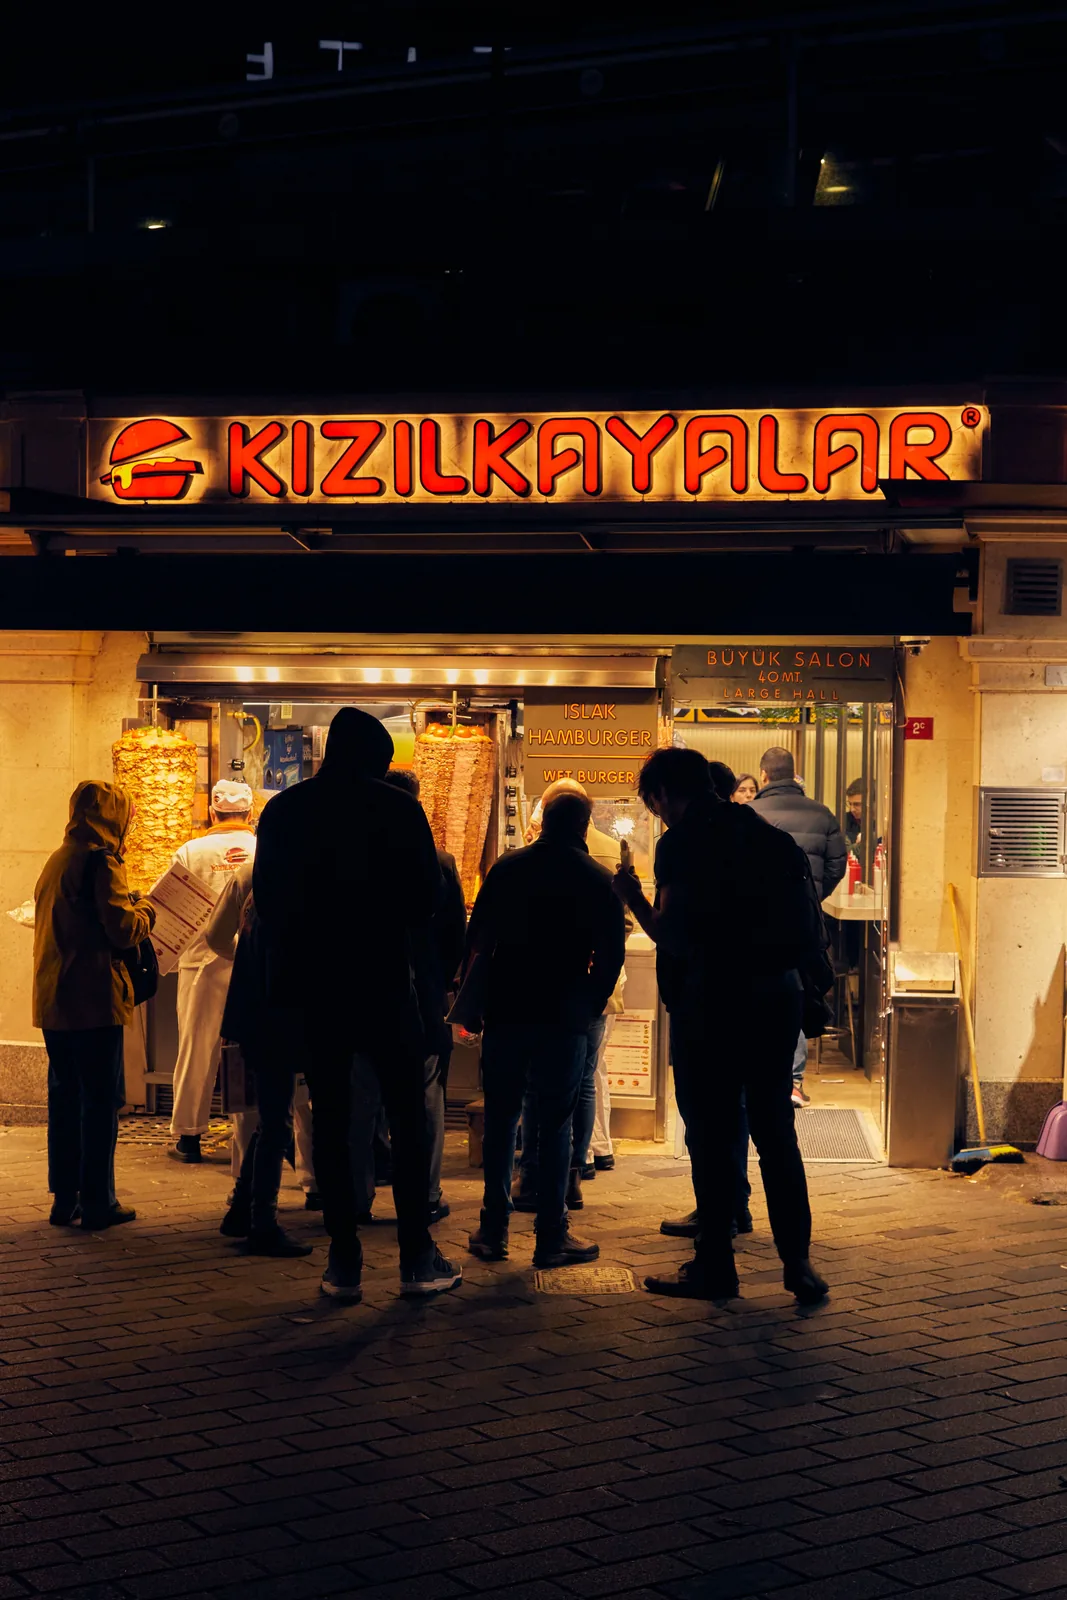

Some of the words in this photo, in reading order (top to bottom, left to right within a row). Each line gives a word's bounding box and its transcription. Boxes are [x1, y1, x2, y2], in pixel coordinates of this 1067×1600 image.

[227, 412, 952, 498] KIZILKAYALAR
[707, 648, 781, 666] BÜYÜK
[794, 651, 870, 667] SALON
[723, 688, 781, 699] LARGE
[793, 689, 839, 700] HALL
[564, 703, 617, 720] ISLAK
[528, 729, 652, 746] HAMBURGER
[543, 770, 573, 782] WET
[577, 770, 635, 783] BURGER
